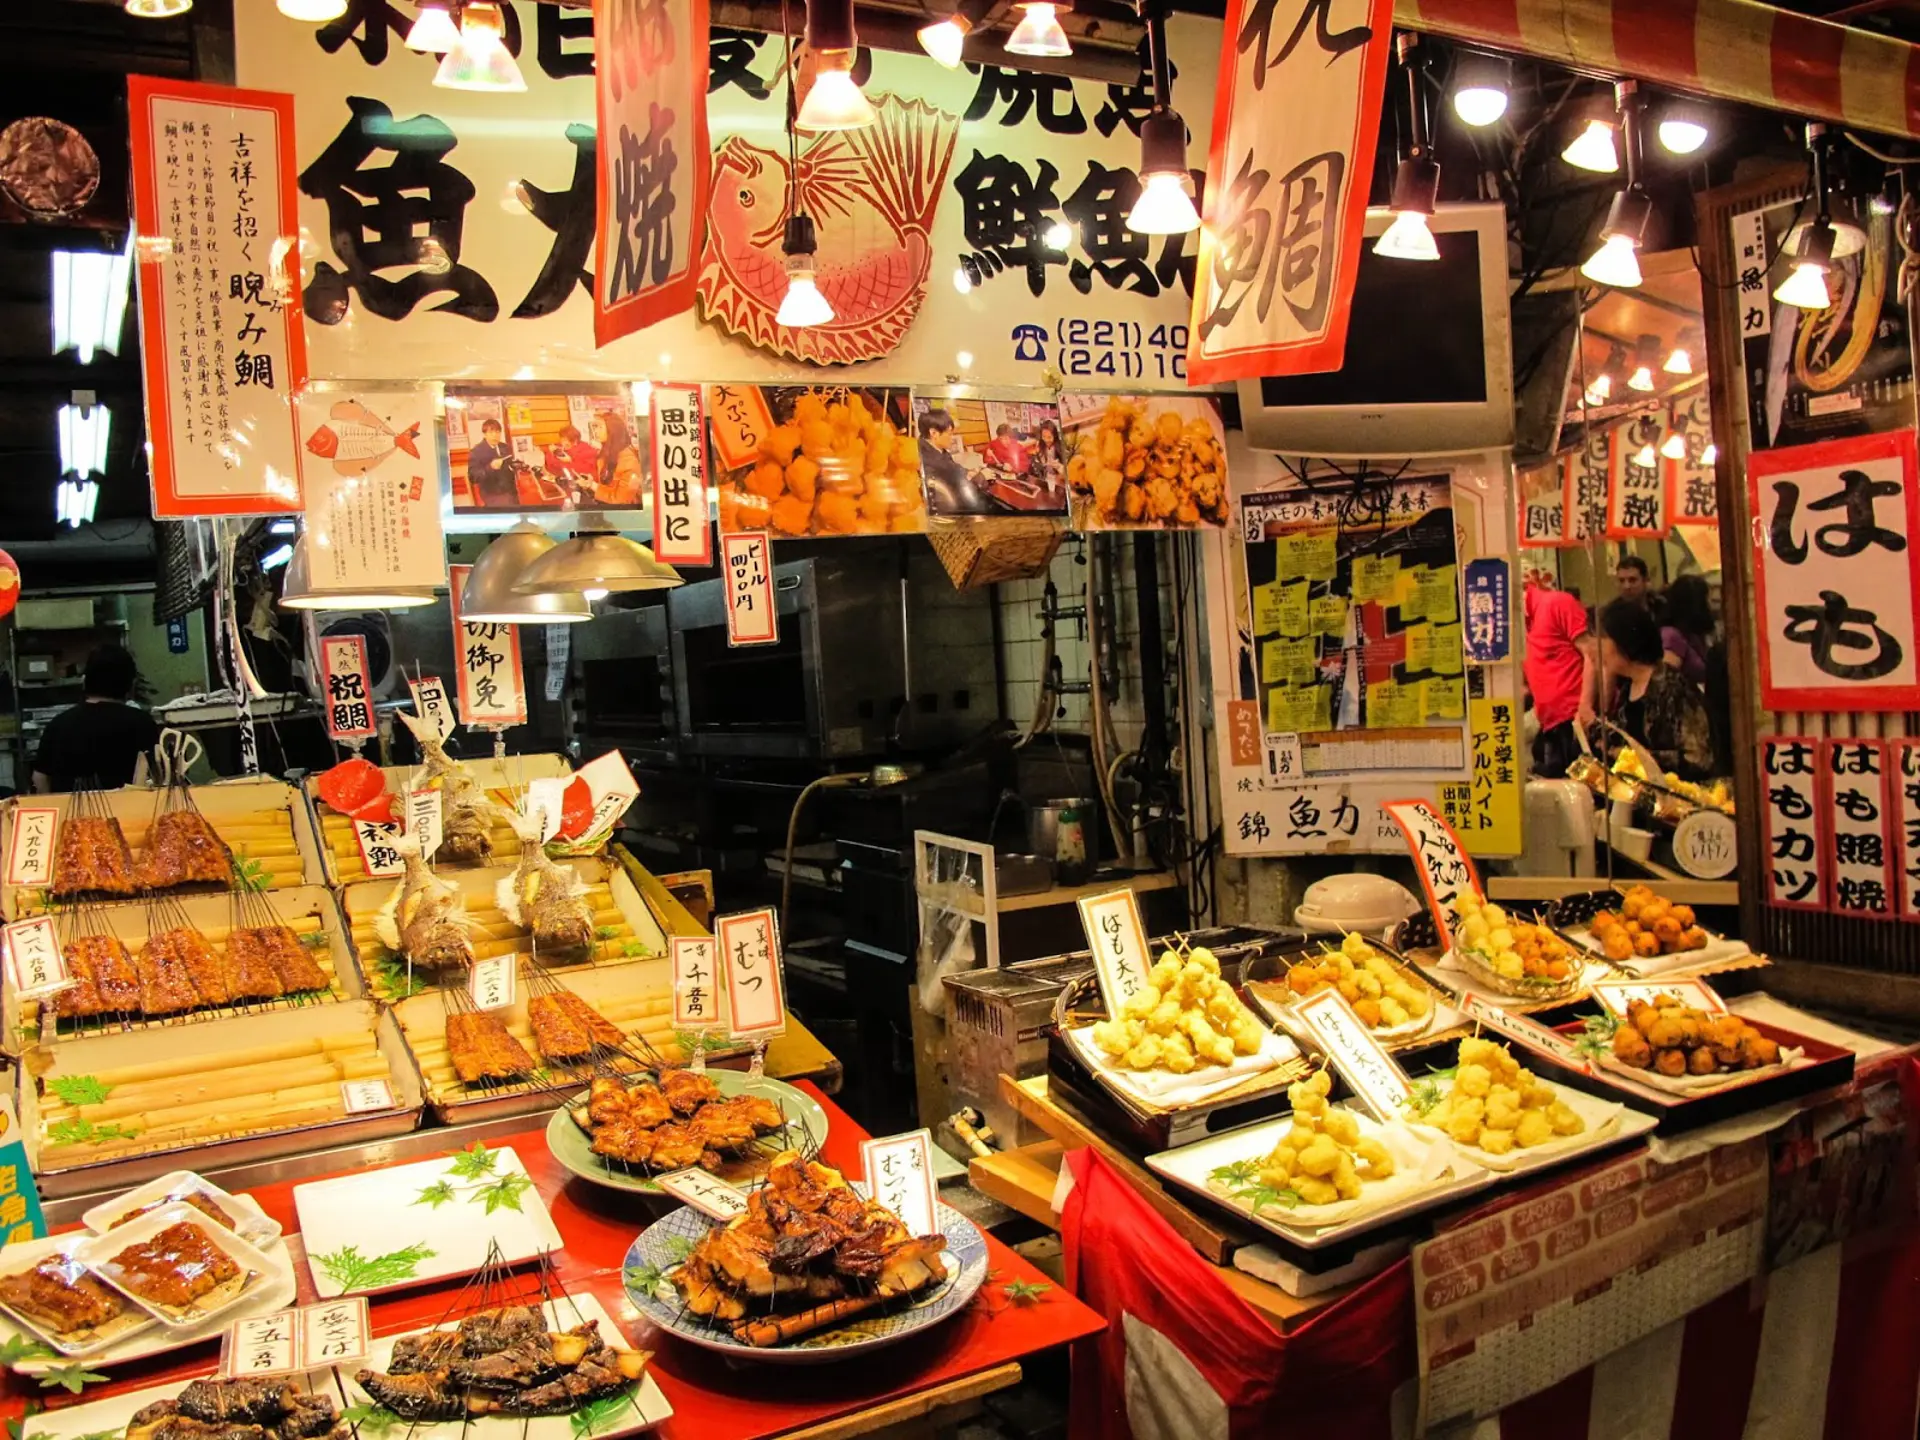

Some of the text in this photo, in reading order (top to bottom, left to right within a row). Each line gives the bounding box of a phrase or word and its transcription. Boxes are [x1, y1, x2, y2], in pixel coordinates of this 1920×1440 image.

[660, 407, 691, 542] 思い出に
[749, 540, 768, 585] ビール
[1771, 470, 1907, 681] はも
[328, 672, 370, 732] 祝鯛
[1472, 732, 1493, 830] アルバイト
[1492, 705, 1513, 784] 男子学生
[1237, 811, 1271, 845] 錦
[1286, 795, 1360, 839] 魚力
[1458, 780, 1472, 830] 間以上
[1765, 742, 1818, 901] はもカツ
[1831, 743, 1887, 913] はも照焼
[734, 941, 763, 992] むつ
